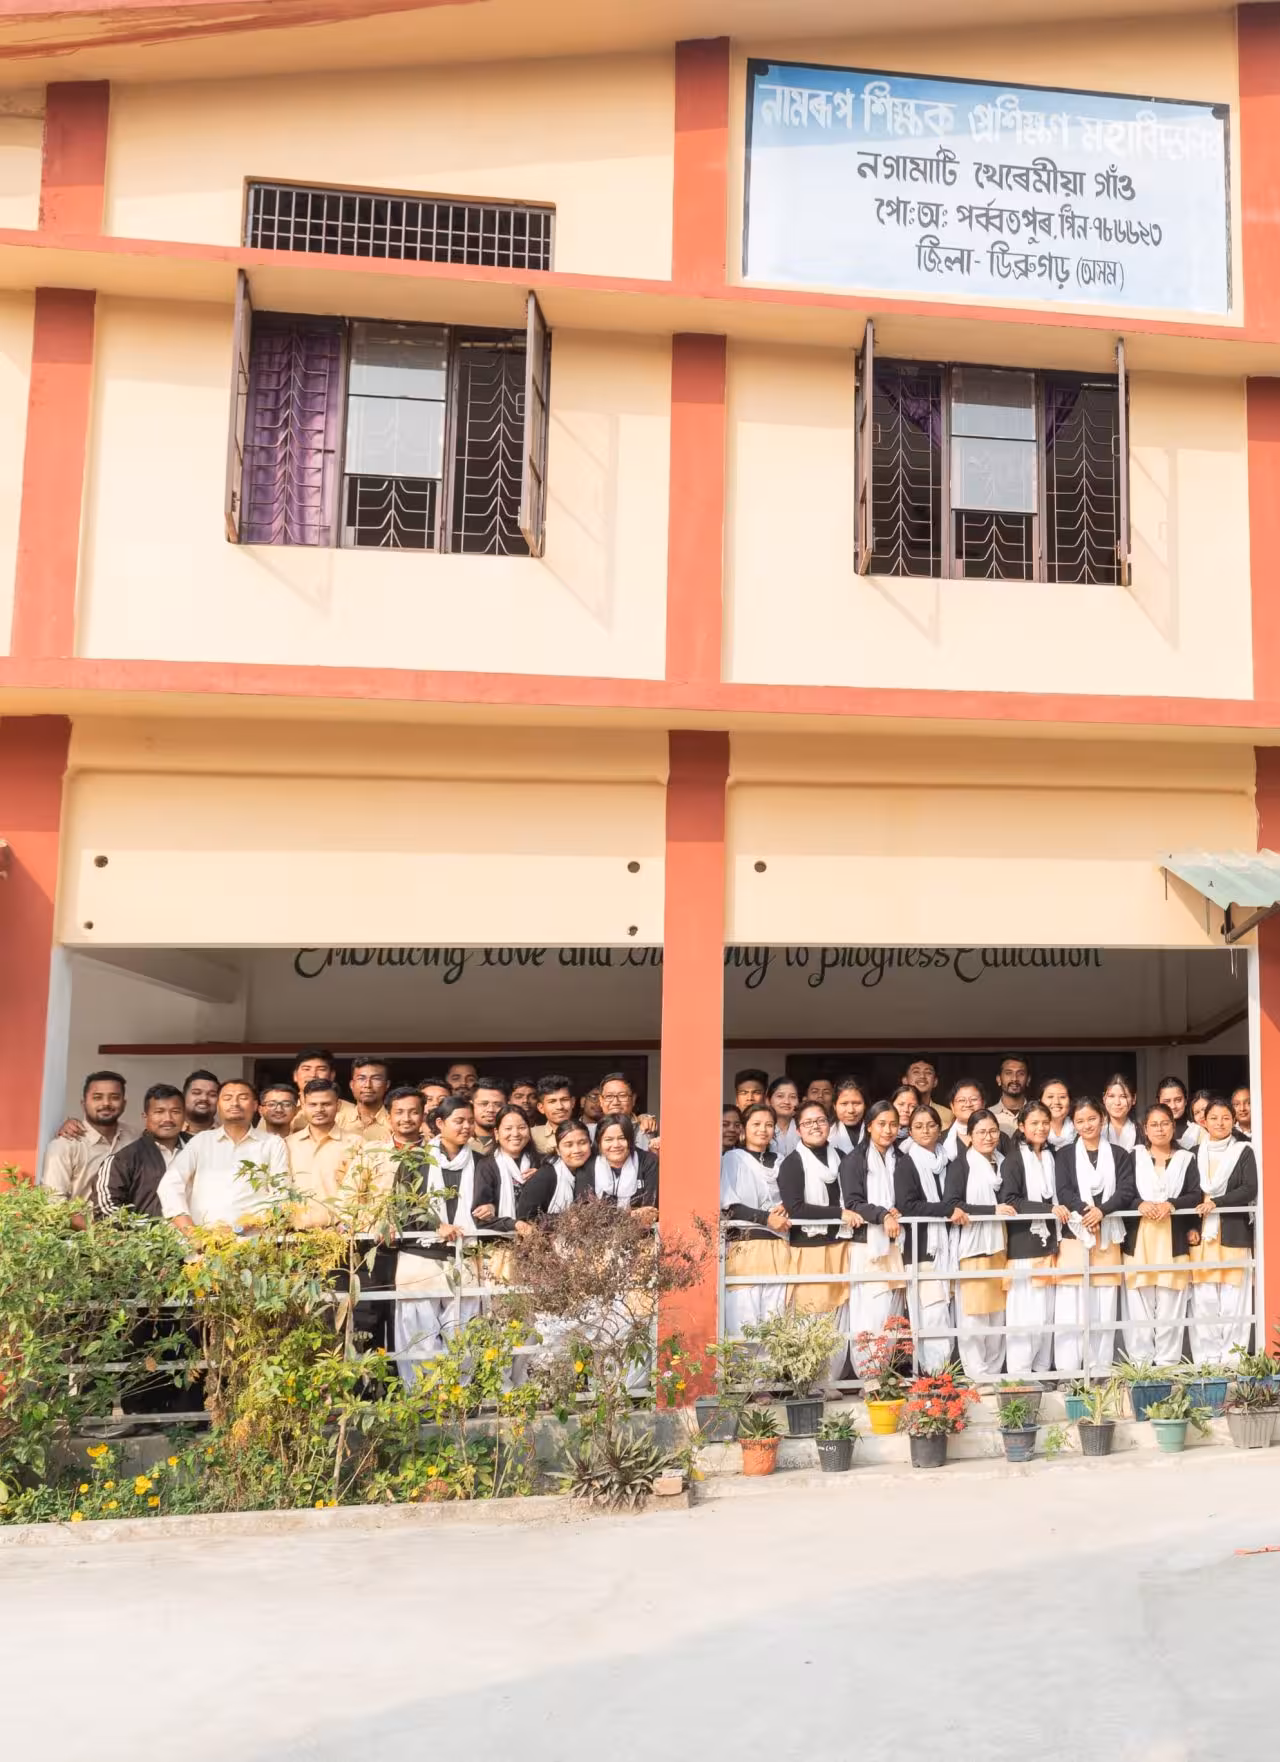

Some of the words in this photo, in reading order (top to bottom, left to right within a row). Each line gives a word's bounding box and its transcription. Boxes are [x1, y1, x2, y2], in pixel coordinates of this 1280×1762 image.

[861, 80, 957, 137] শিক্ষক
[857, 144, 960, 186] নগামাটি
[1095, 164, 1136, 200] গাঁও
